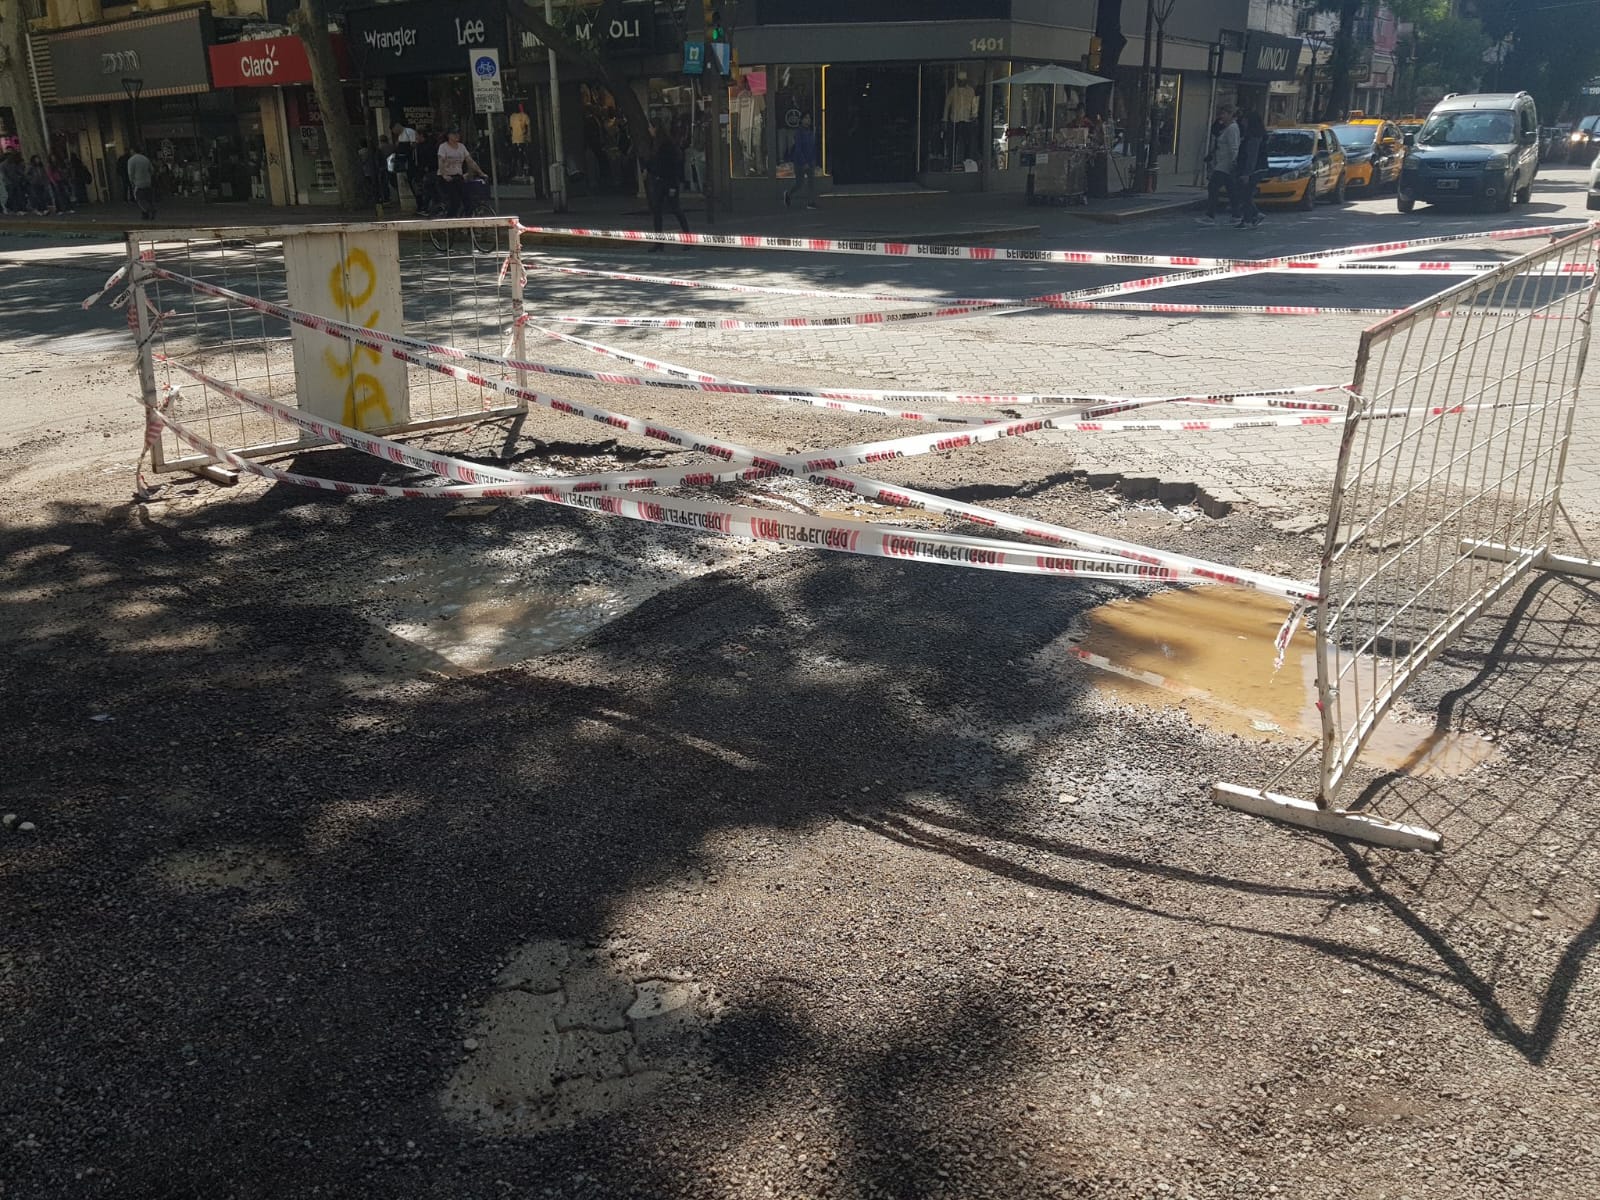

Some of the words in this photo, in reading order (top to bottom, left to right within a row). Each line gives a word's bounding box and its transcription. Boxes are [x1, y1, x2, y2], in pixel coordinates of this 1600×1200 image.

[364, 26, 417, 57] Wrangler
[455, 17, 486, 45] Lee
[969, 38, 1004, 52] 1401
[240, 53, 275, 79] Claro
[1257, 46, 1290, 71] MINOLI
